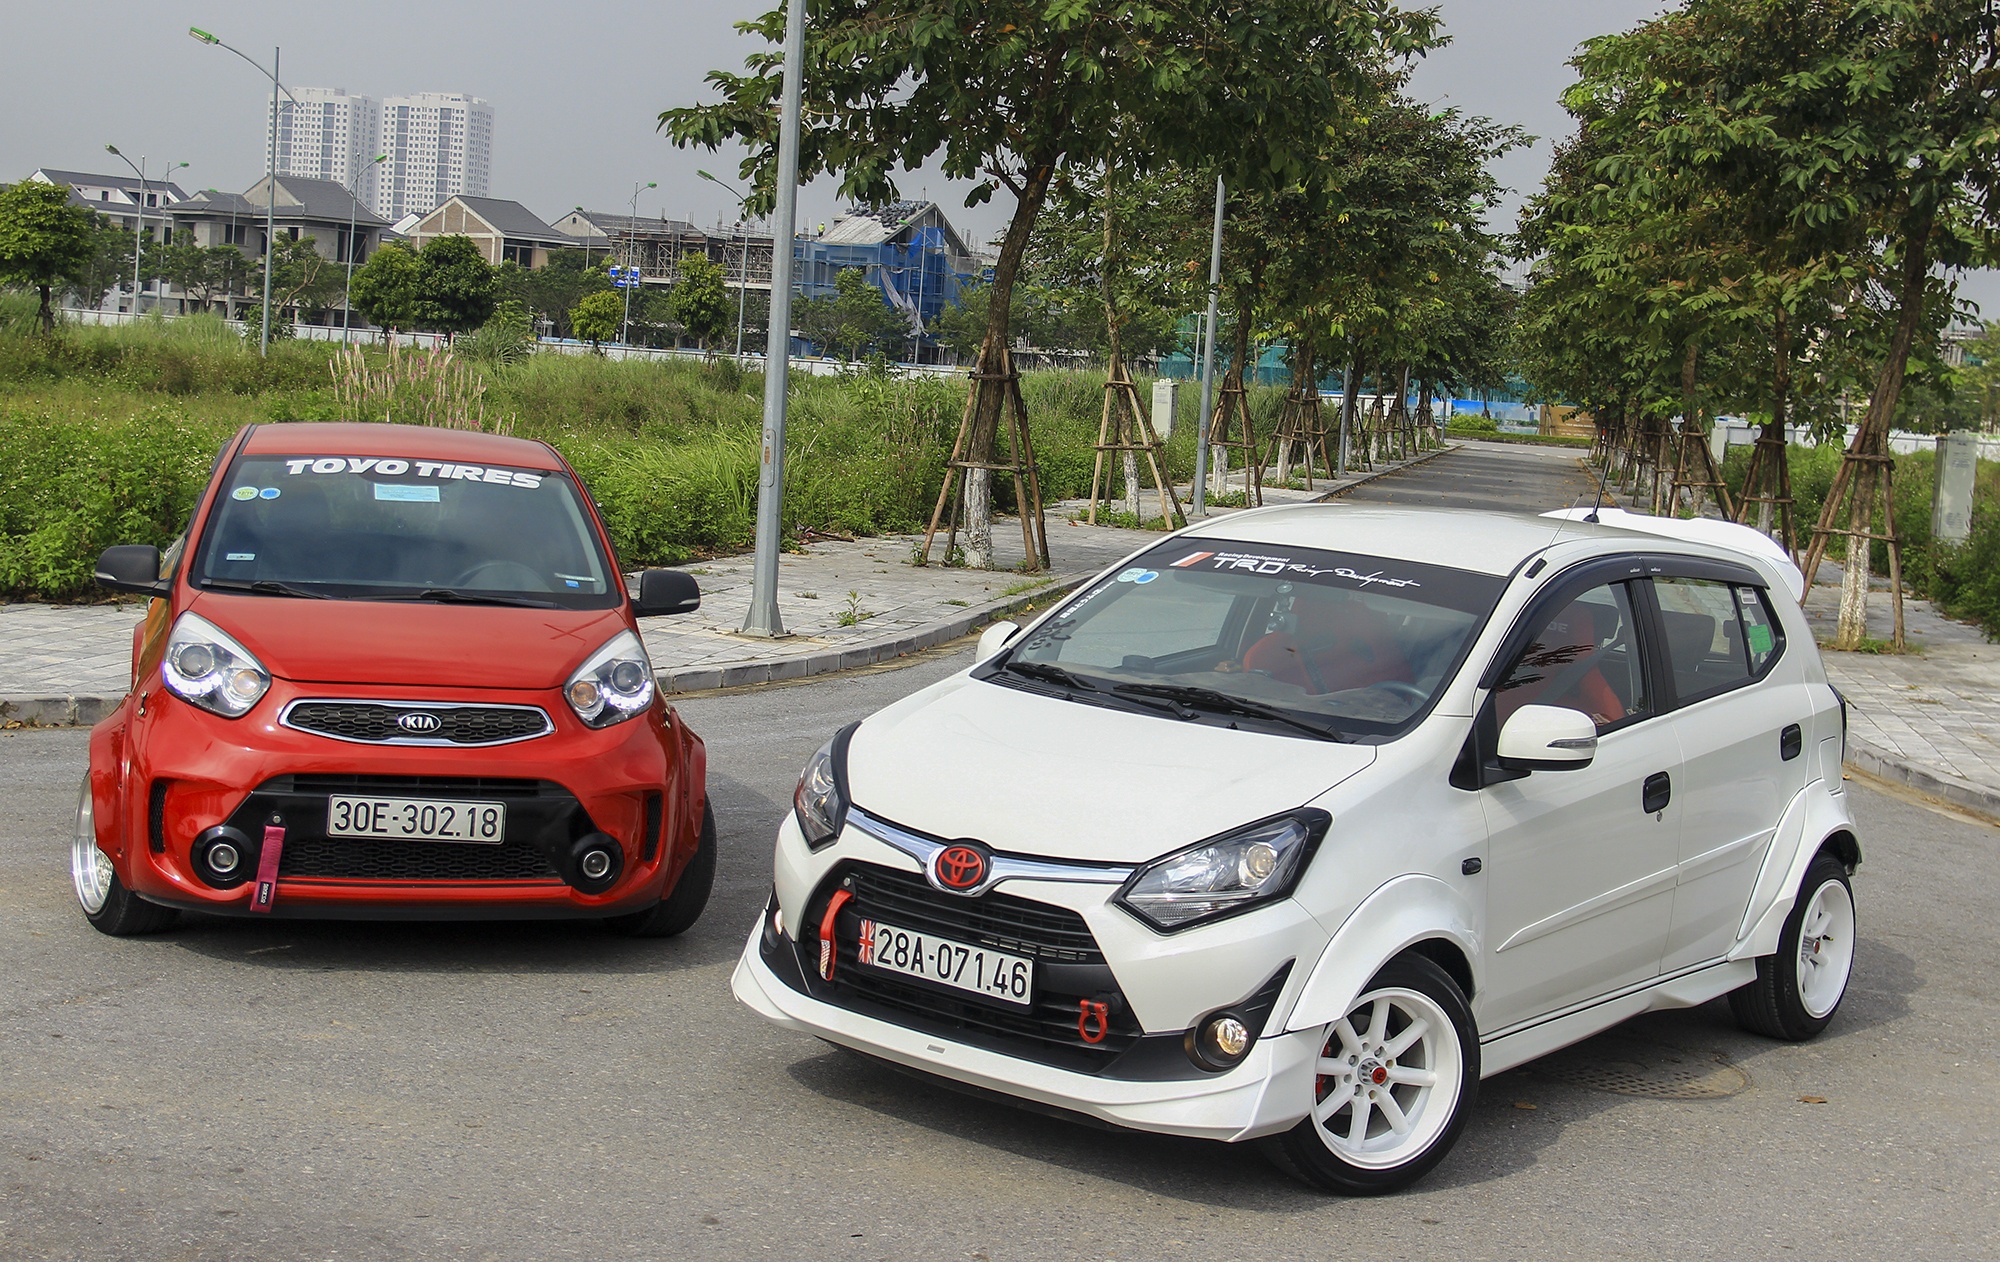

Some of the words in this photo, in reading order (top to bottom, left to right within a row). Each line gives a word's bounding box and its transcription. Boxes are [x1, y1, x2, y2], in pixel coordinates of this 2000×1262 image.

[286, 458, 410, 475] TOYO
[415, 462, 543, 489] TIRES
[1213, 557, 1286, 575] TRD
[1243, 554, 1291, 564] Development
[406, 716, 435, 729] KIA
[334, 801, 498, 838] 30E-302.18
[877, 928, 1028, 998] 28A-071.46
